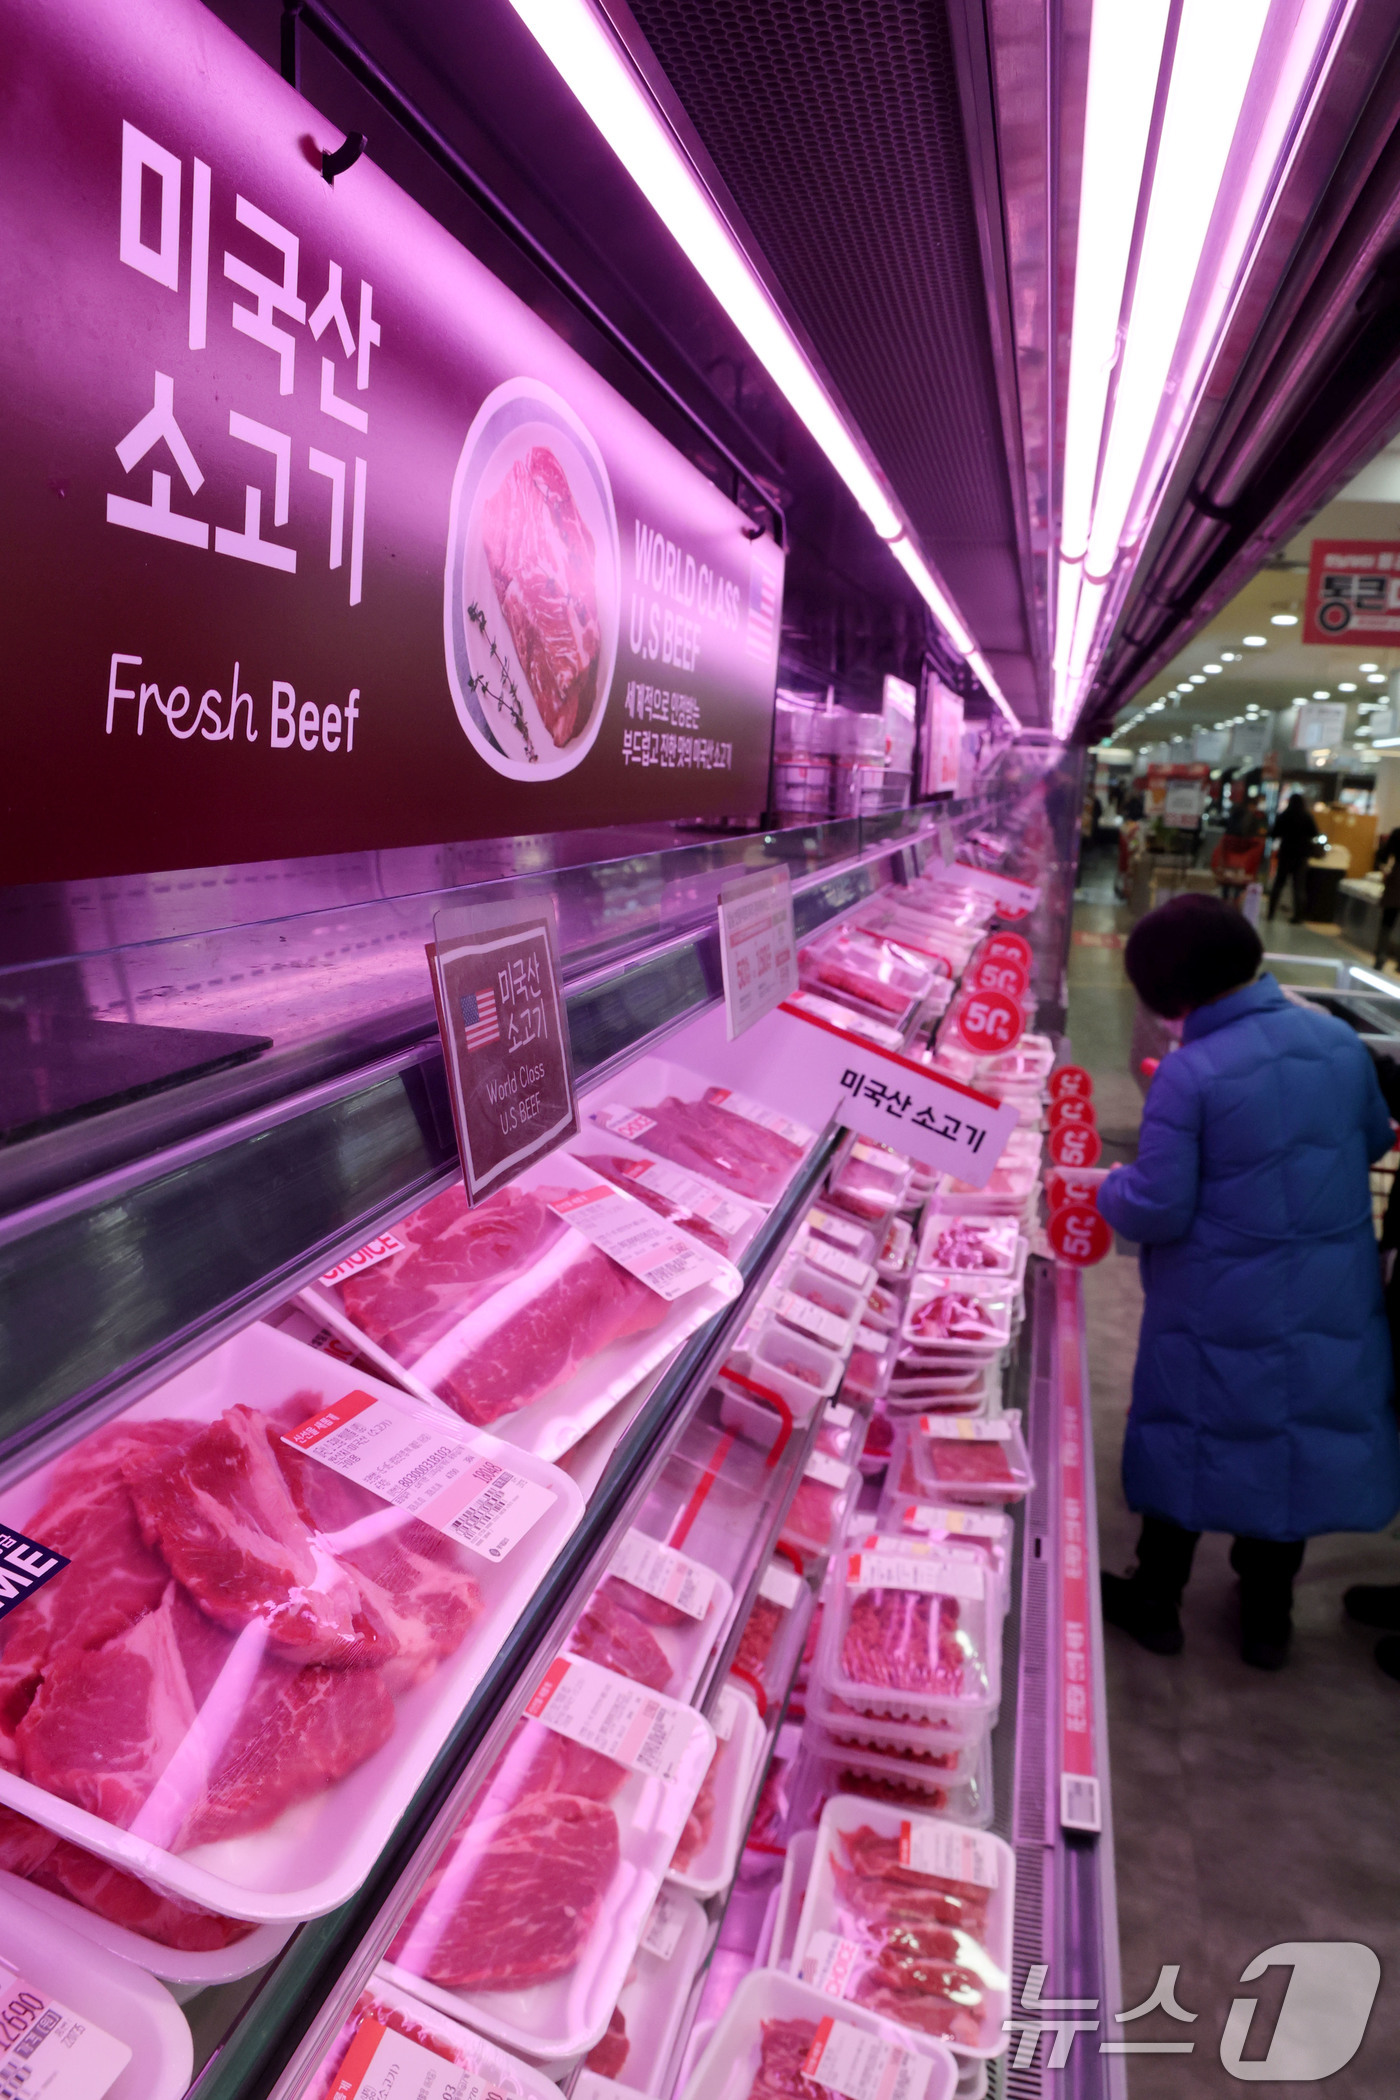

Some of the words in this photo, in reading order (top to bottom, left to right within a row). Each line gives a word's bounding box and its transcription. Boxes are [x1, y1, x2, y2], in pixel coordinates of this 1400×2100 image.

[120, 119, 381, 434] 미국산
[106, 370, 367, 606] 소고기
[635, 518, 697, 607] WORLD
[697, 563, 741, 632] CLASS
[630, 592, 660, 661] U.S
[662, 608, 701, 672] BEEF
[105, 652, 258, 743] Fresh
[270, 680, 360, 753] Beef
[625, 681, 669, 722] 세계적으로
[622, 729, 659, 767] 부드럽고
[498, 951, 542, 1005] 미국산
[507, 998, 548, 1053] 소고기
[486, 1070, 518, 1105] World
[519, 1062, 545, 1090] Class
[499, 1105, 518, 1136] U.S
[519, 1091, 542, 1123] BEEF
[840, 1069, 912, 1119] 미국산
[911, 1105, 986, 1154] 소고기
[398, 1446, 452, 1488] 803000318103
[472, 1461, 504, 1484] 18048
